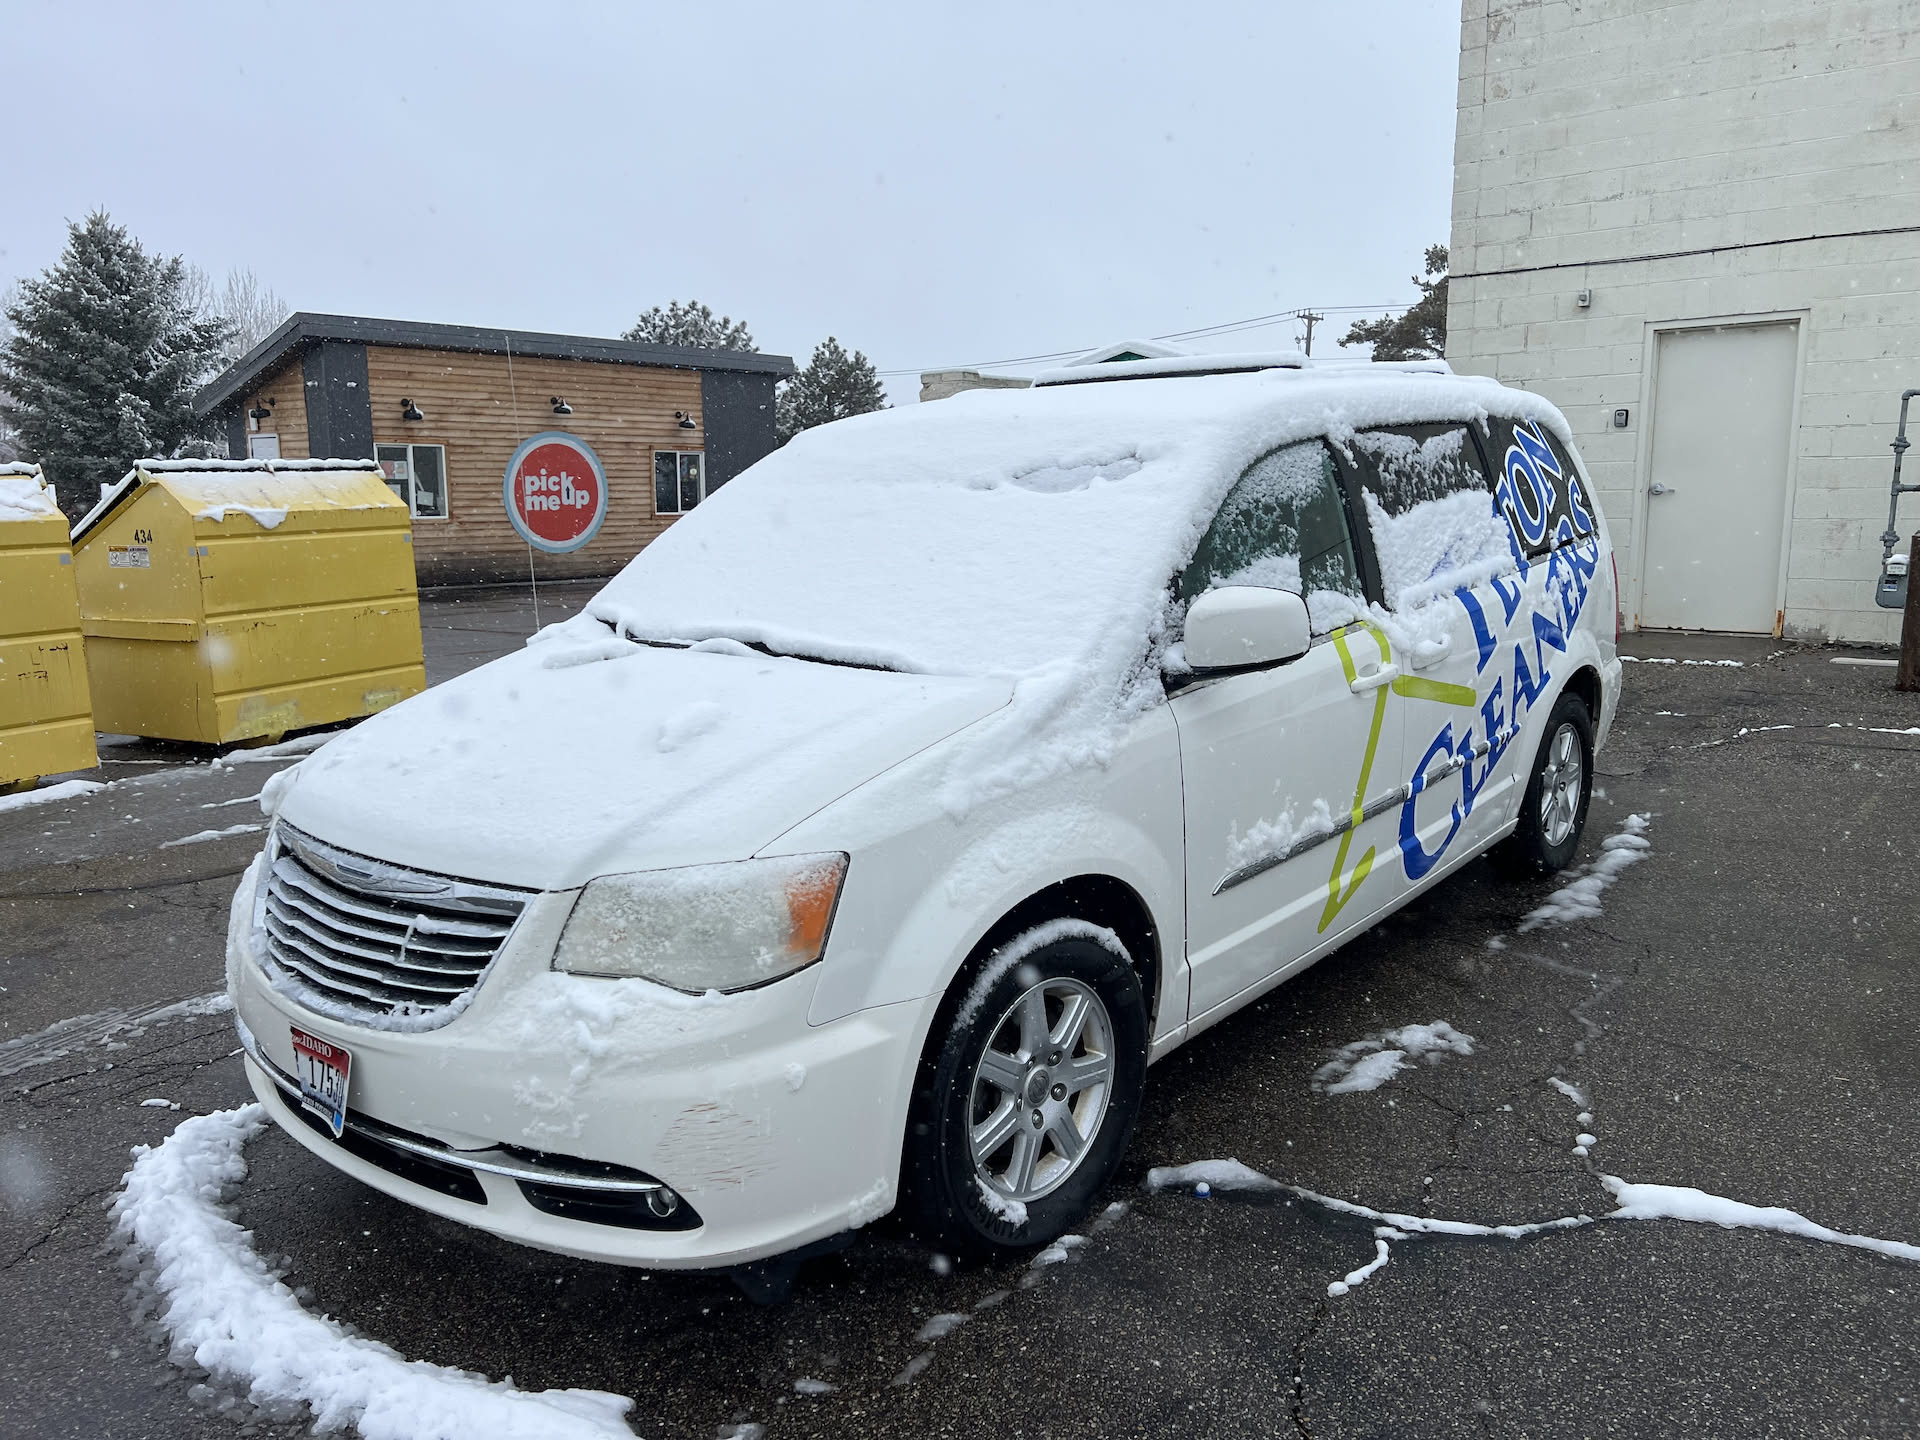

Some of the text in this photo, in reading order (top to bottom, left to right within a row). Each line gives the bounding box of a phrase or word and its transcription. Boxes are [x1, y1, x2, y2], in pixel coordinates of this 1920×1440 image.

[524, 468, 575, 496] pick
[525, 487, 590, 511] me up
[134, 529, 153, 544] 434
[1452, 418, 1563, 677] TON
[1398, 474, 1600, 881] CLEANERS
[301, 1034, 332, 1058] IDAHO
